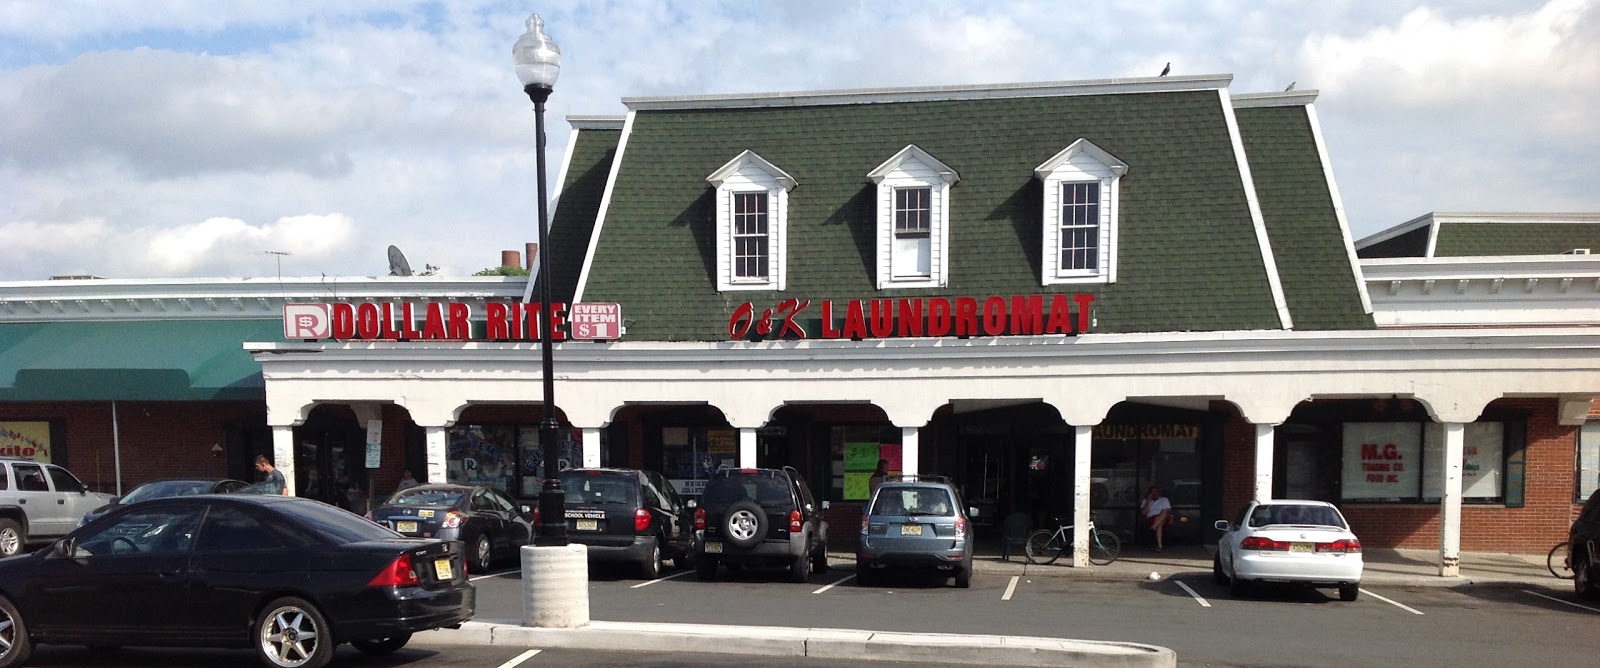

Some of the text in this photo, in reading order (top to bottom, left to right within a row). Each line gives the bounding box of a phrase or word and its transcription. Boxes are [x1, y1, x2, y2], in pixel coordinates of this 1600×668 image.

[574, 305, 616, 314] EVERY
[728, 293, 1095, 339] O & K LAUNDROMAT
[333, 302, 566, 340] DOLLAR RITE
[574, 314, 616, 323] ITEM
[578, 323, 612, 338] $1
[1361, 443, 1403, 460] M.G.
